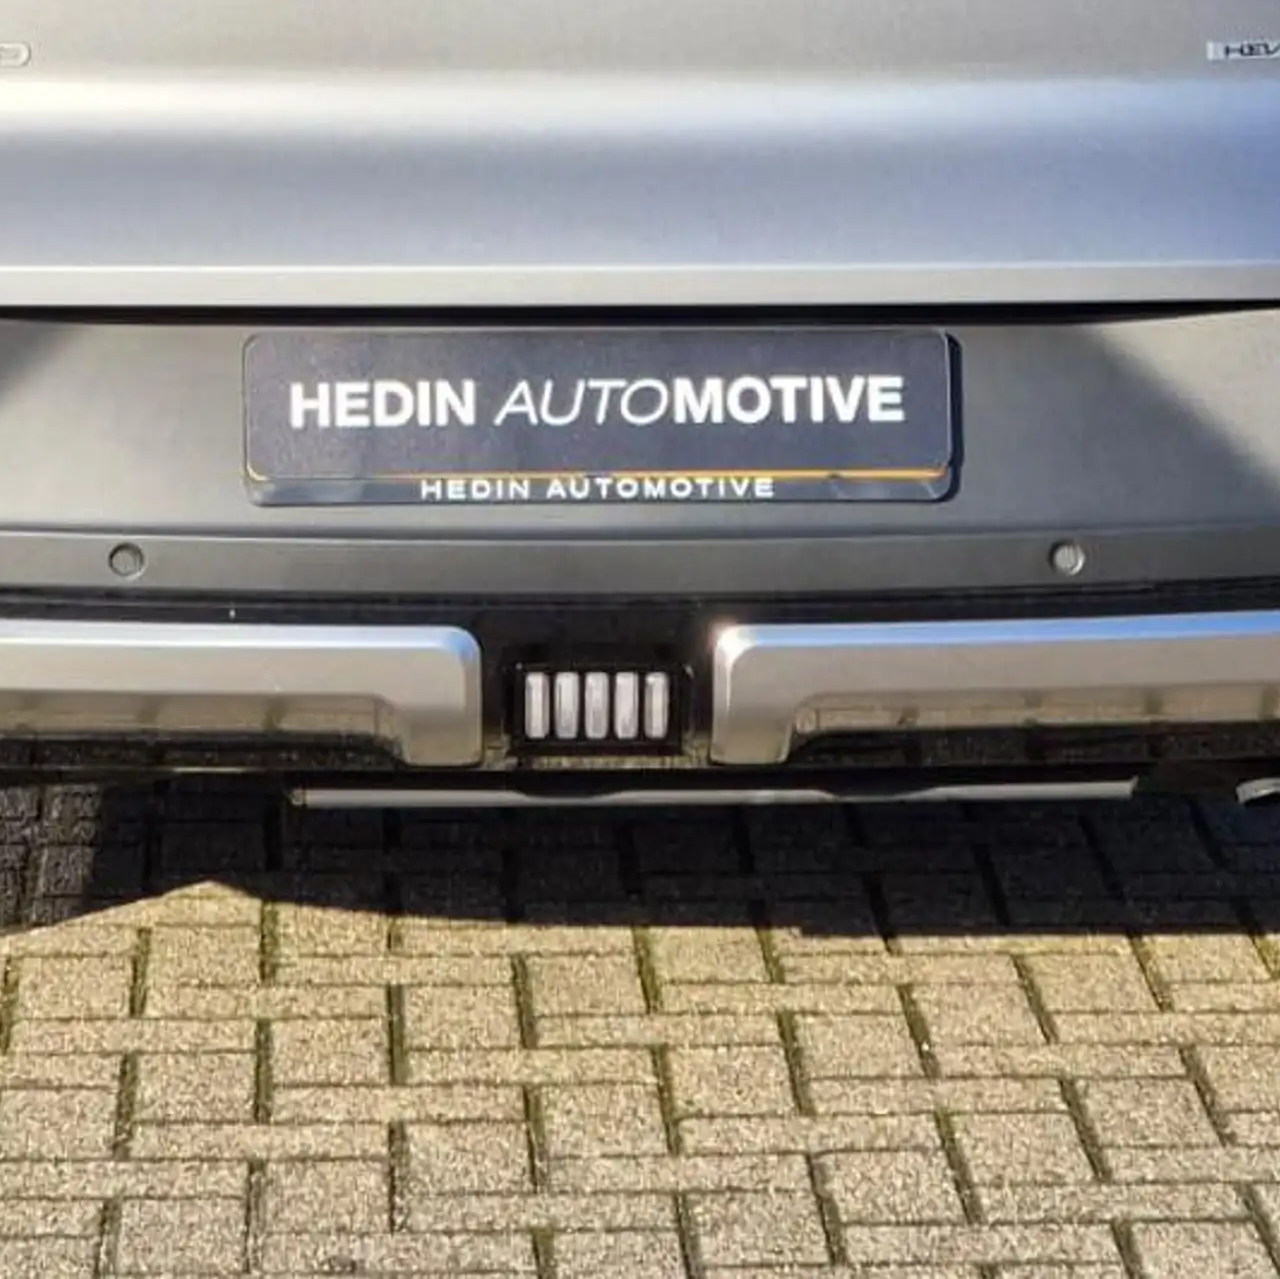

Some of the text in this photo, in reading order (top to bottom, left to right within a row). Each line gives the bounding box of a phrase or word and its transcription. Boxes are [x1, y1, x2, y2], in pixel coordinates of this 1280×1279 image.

[290, 375, 905, 428] HEDIN AUTOMOTIVE
[420, 477, 774, 499] HEDIN AUTOMOTIVE
